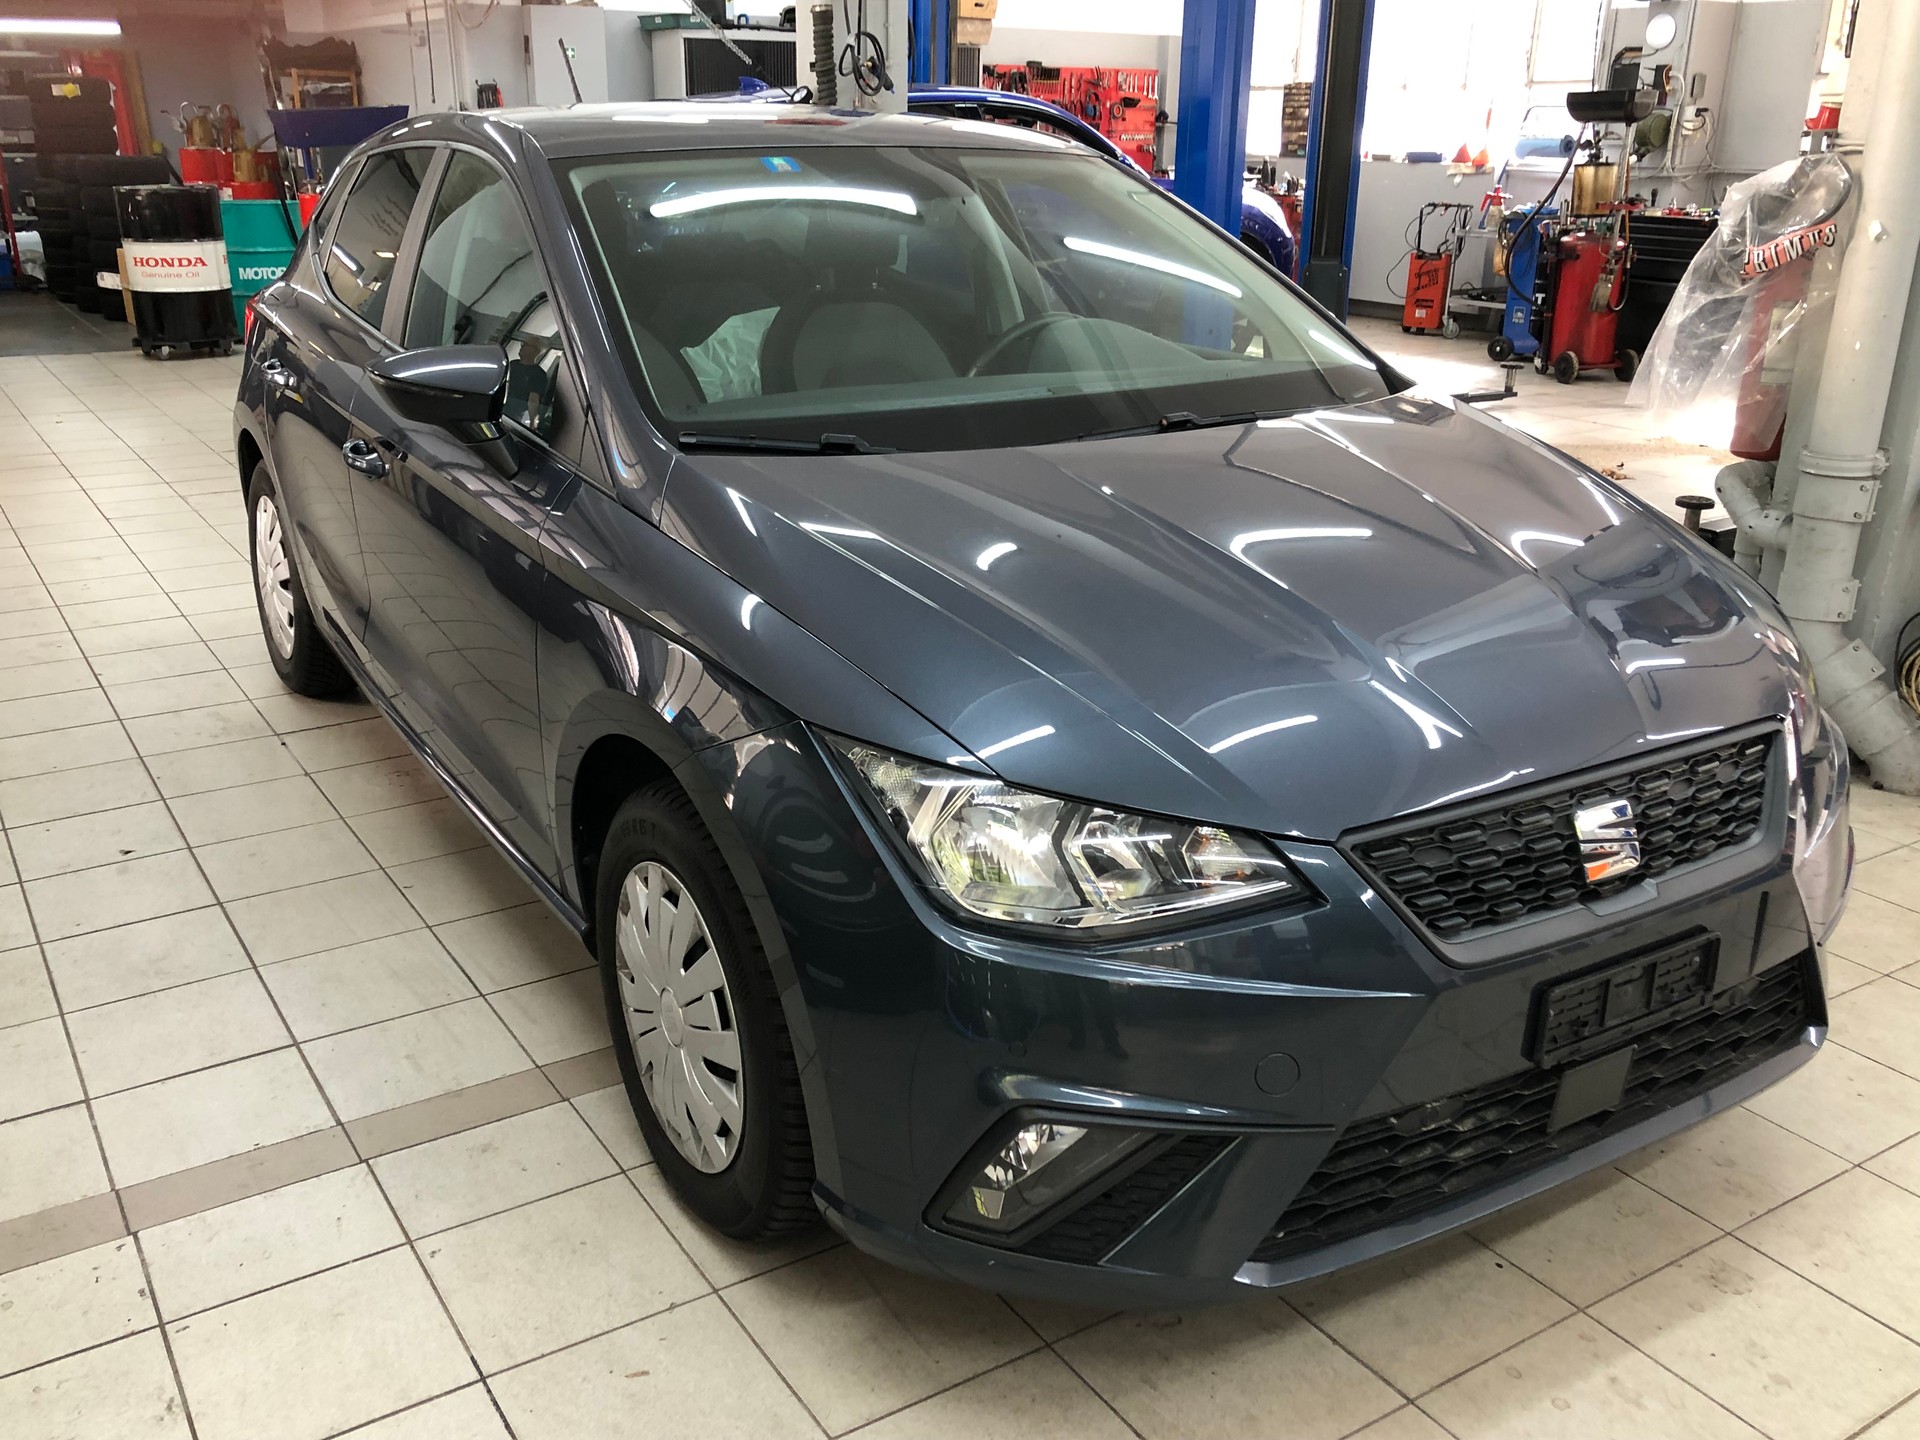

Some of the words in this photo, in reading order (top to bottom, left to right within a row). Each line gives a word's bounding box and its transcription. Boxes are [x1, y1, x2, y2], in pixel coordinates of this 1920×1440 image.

[132, 256, 209, 268] HONDA
[141, 270, 183, 279] Genuine
[185, 270, 201, 279] Oil
